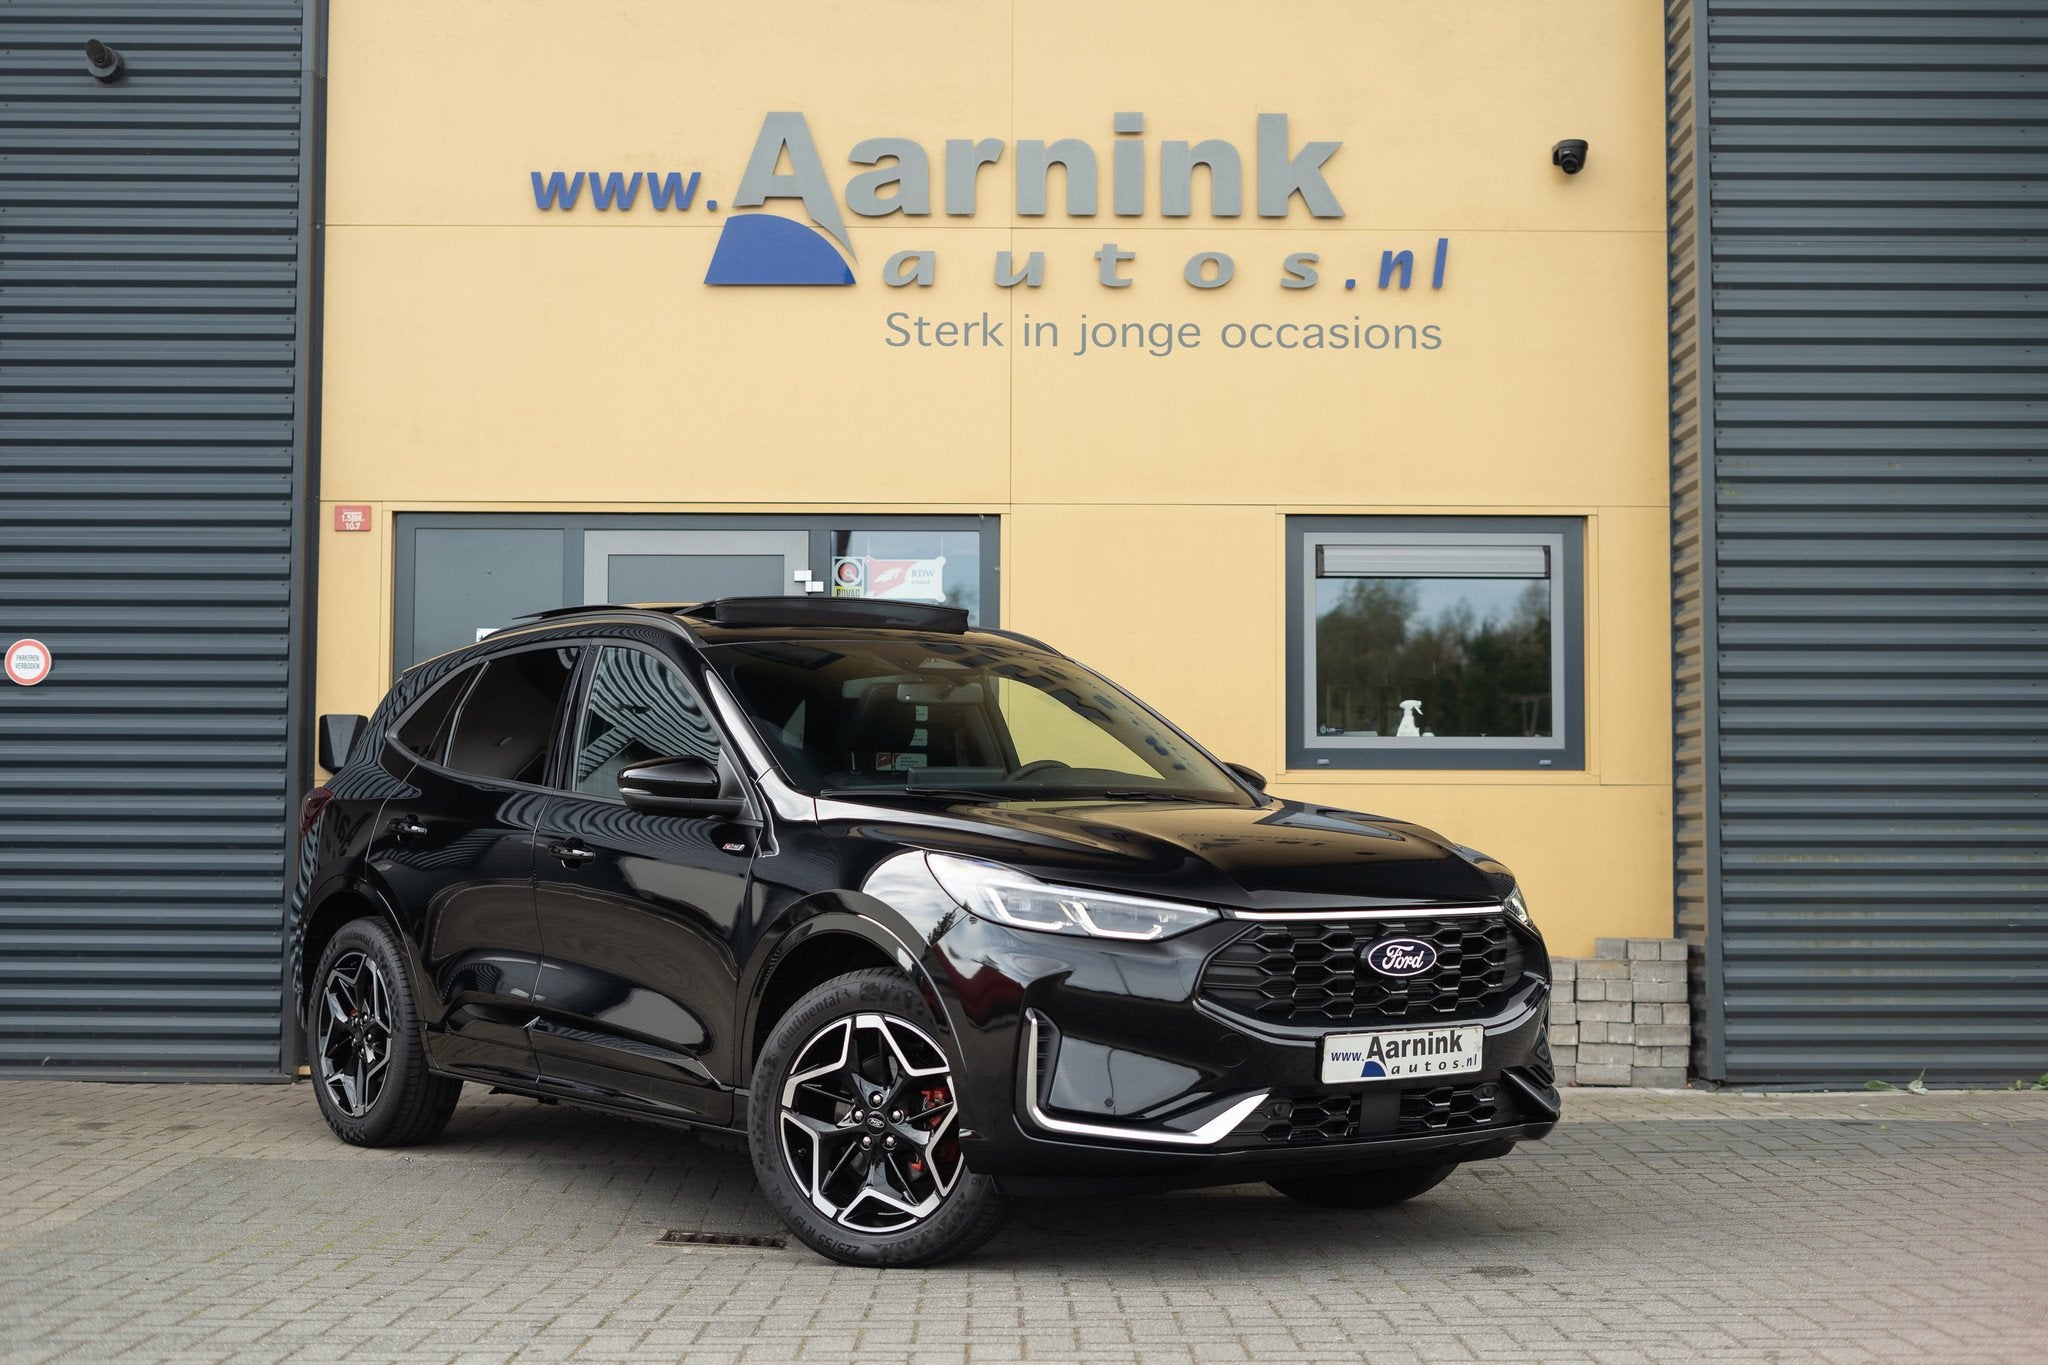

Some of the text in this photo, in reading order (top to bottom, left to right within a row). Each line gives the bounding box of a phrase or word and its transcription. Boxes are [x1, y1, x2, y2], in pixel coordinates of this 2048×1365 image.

[885, 312, 1443, 356] Sterk in jonge occasions
[911, 569, 935, 578] RDW
[1382, 945, 1424, 970] Ford
[778, 991, 843, 1049] Continental
